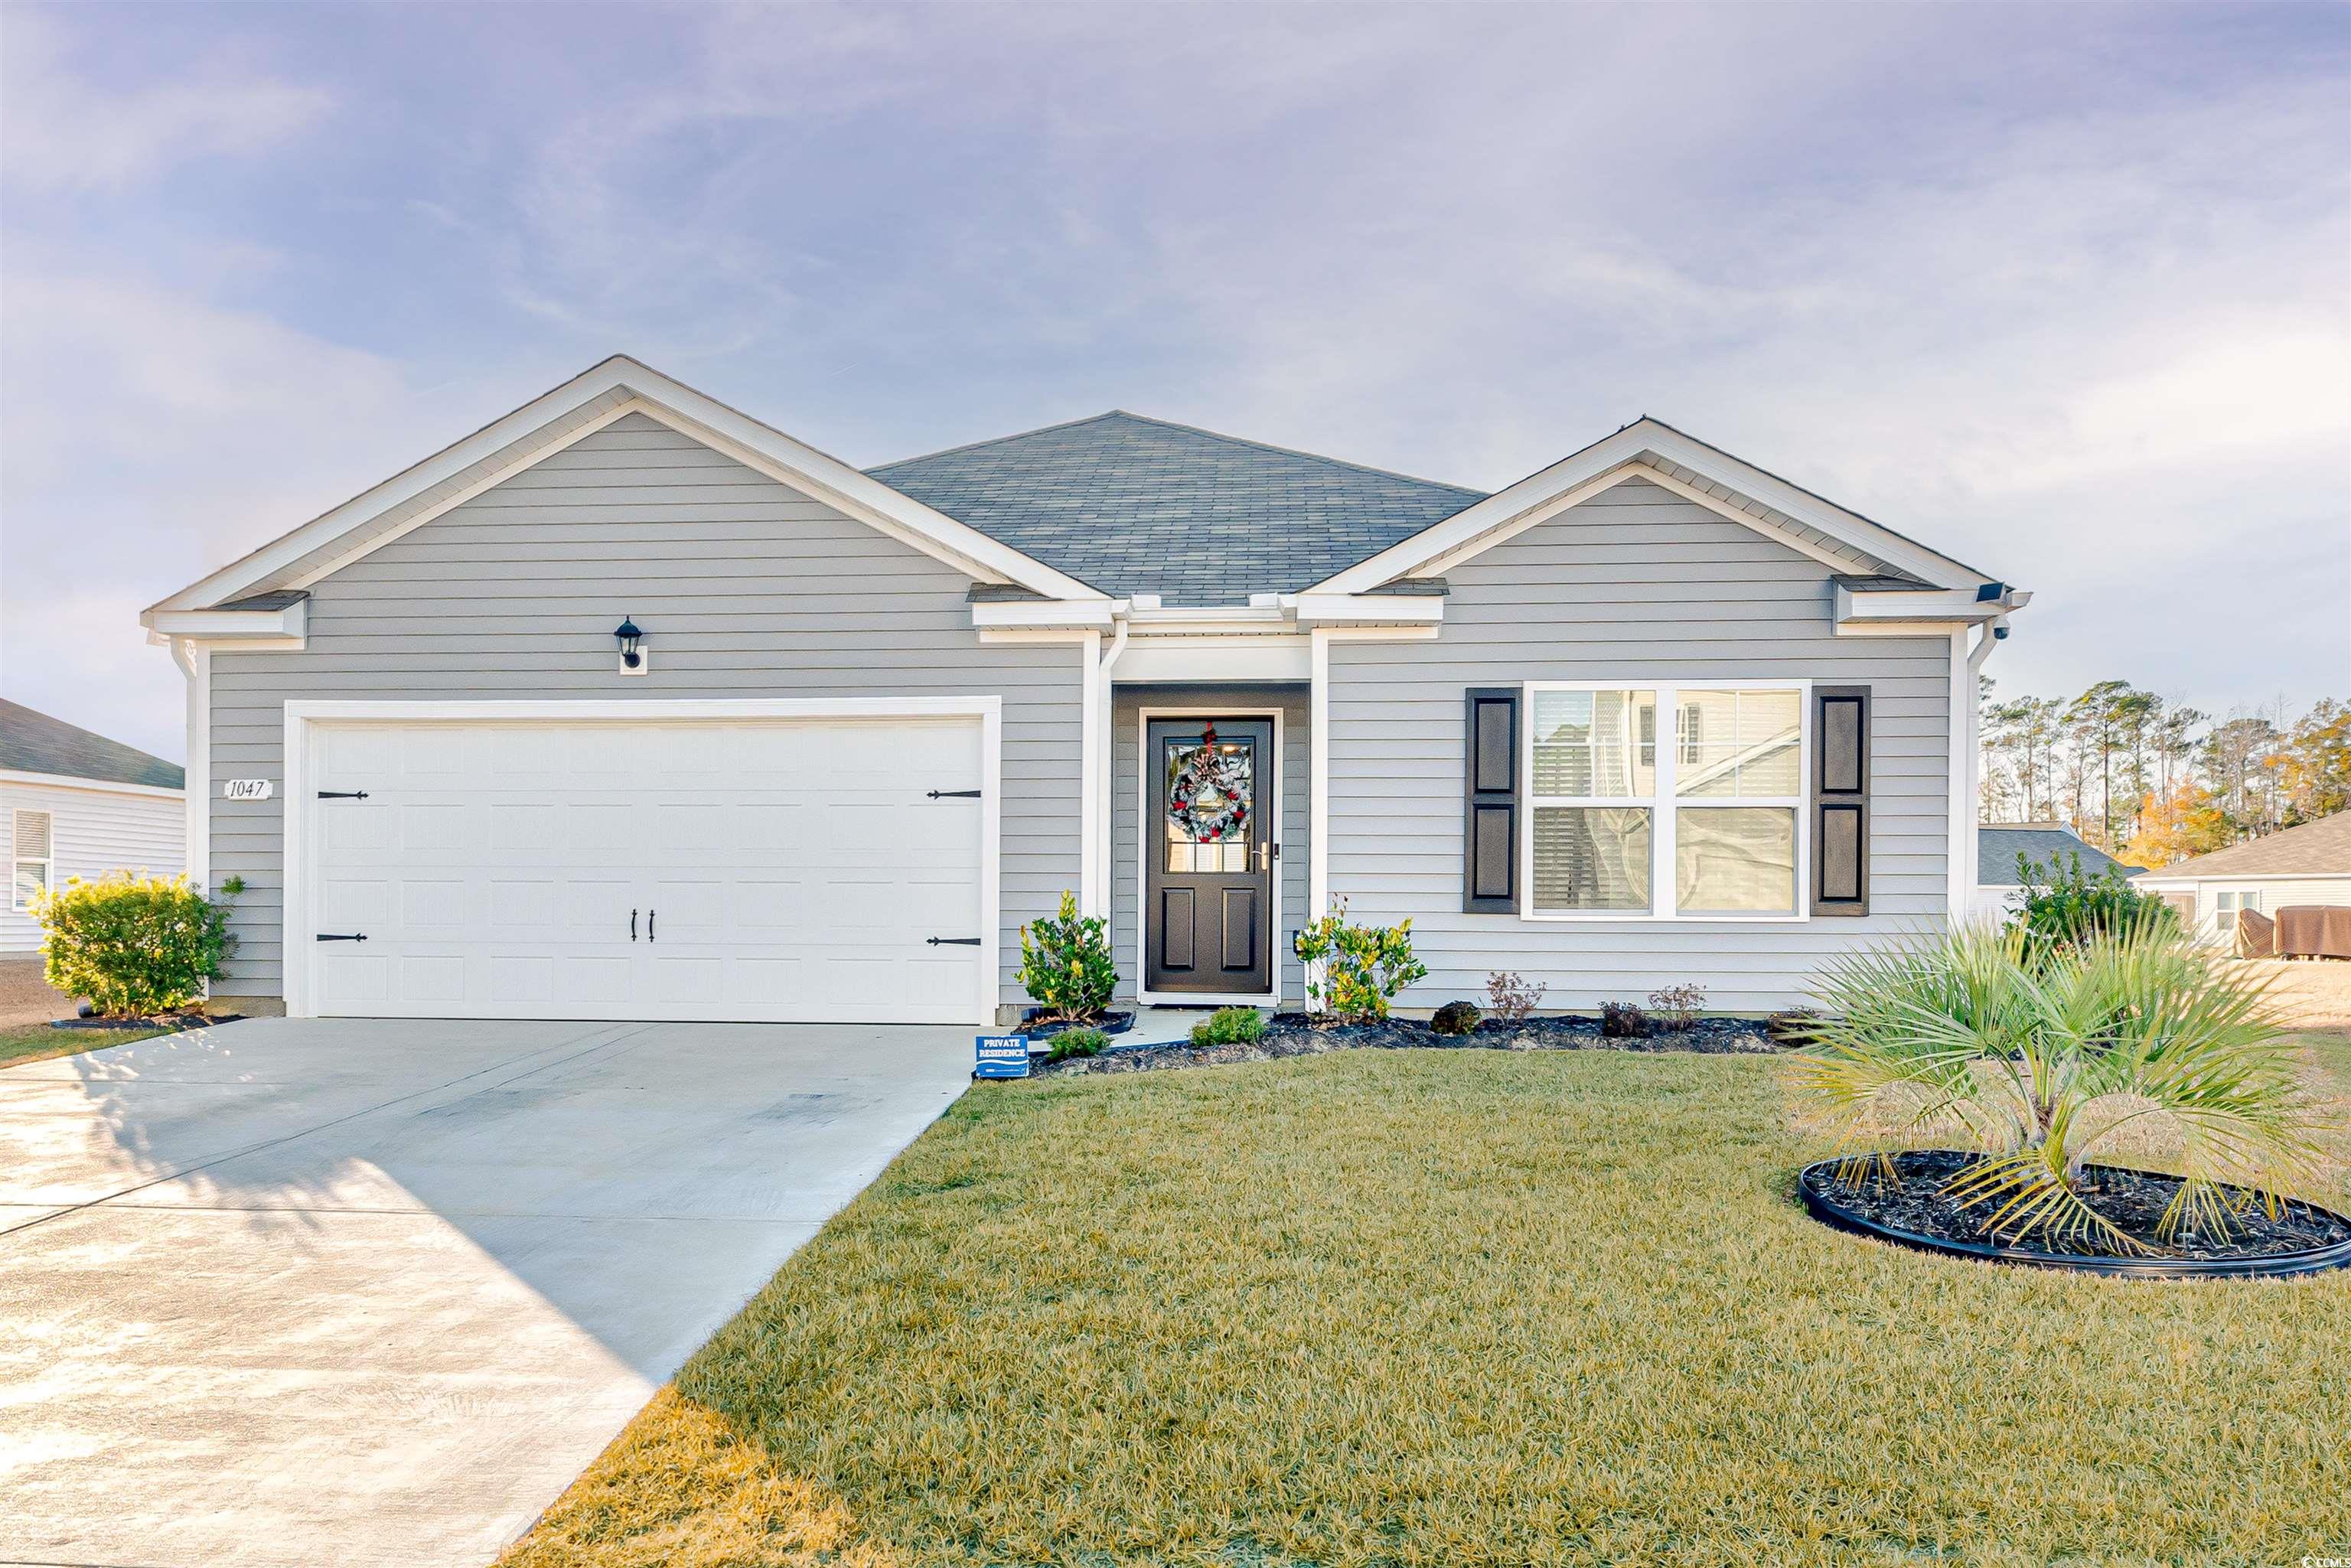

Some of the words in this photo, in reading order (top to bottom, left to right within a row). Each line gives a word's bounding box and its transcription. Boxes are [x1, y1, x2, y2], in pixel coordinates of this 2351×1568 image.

[230, 781, 264, 797] 1047
[983, 1038, 1021, 1048] PRIVATE
[979, 1049, 1026, 1058] RESIDENCE
